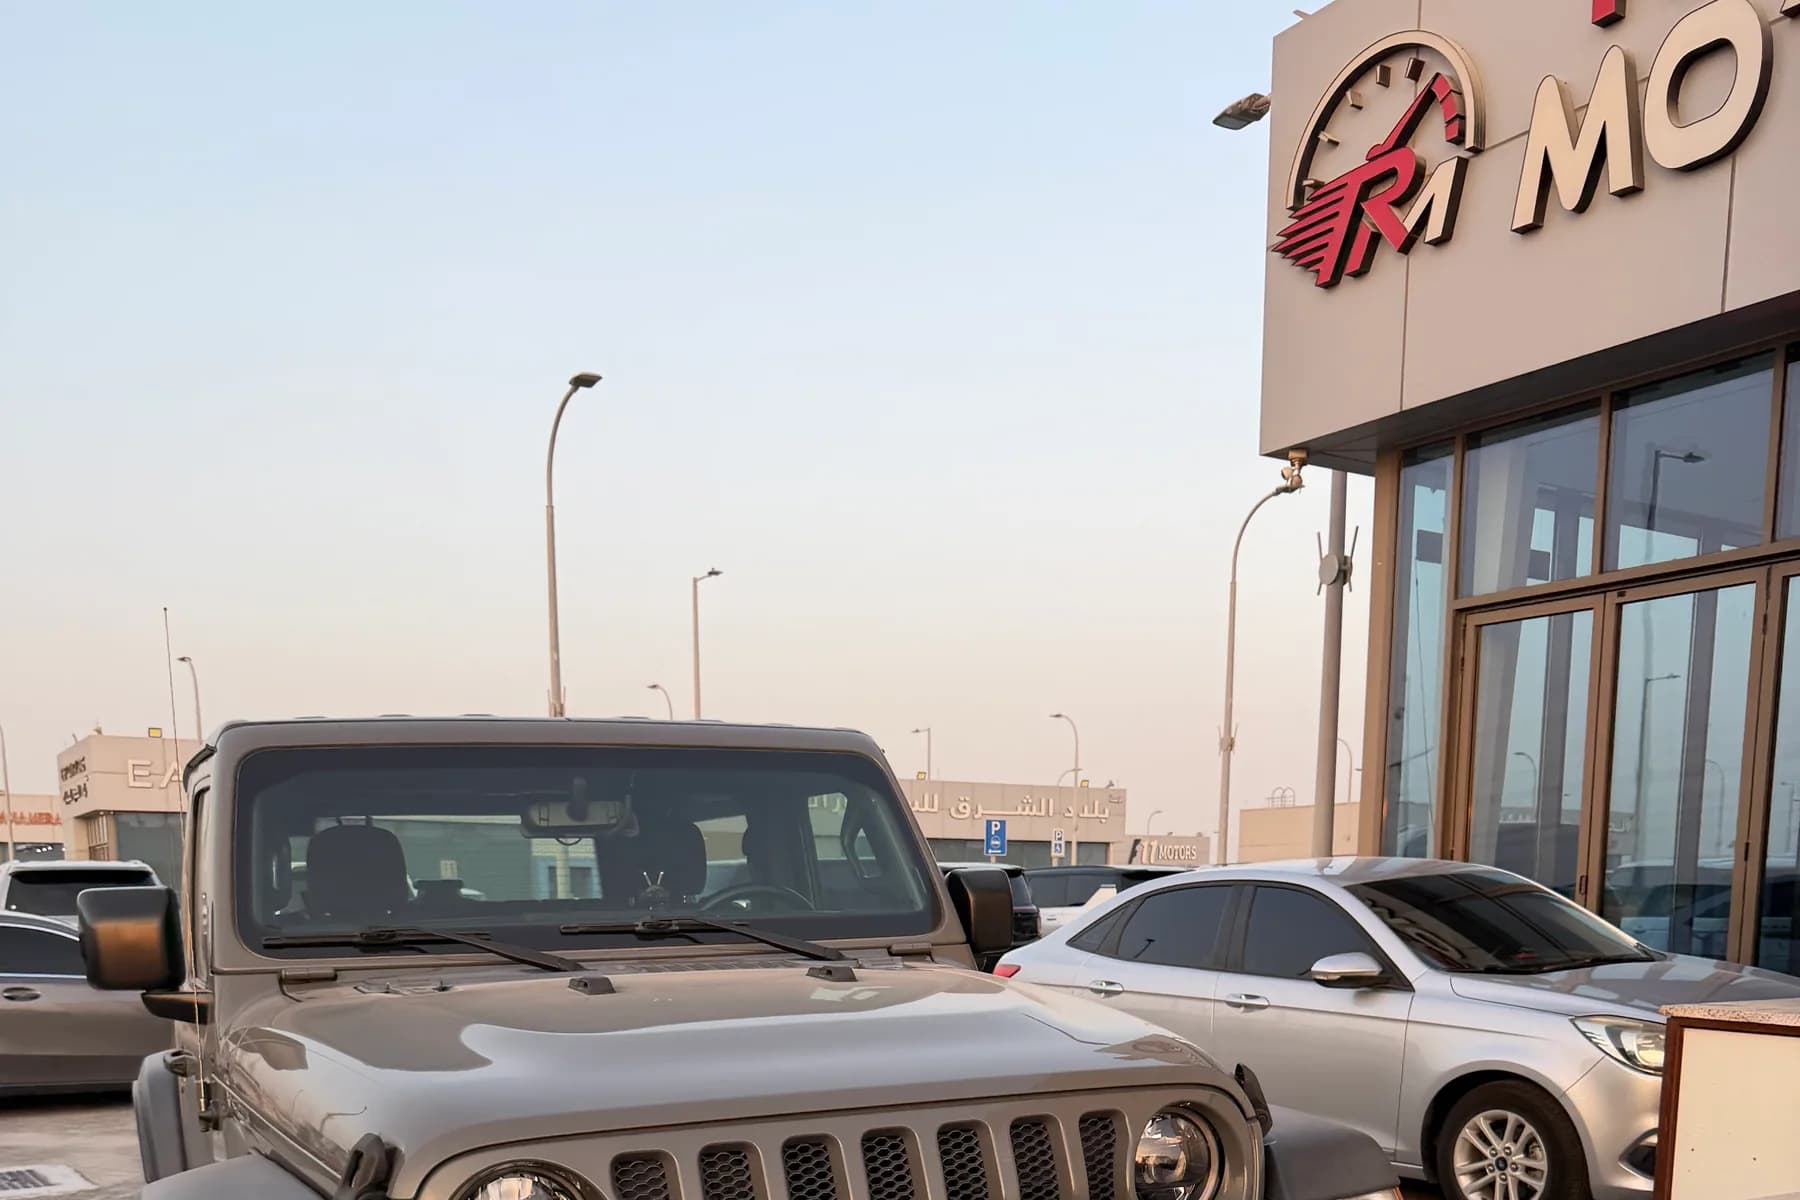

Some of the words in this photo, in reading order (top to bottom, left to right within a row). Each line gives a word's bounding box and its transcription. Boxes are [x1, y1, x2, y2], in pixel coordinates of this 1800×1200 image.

[1511, 0, 1800, 235] MO
[950, 795, 1053, 819] الشرق
[991, 821, 1001, 835] P
[1158, 845, 1197, 860] MOTORS
